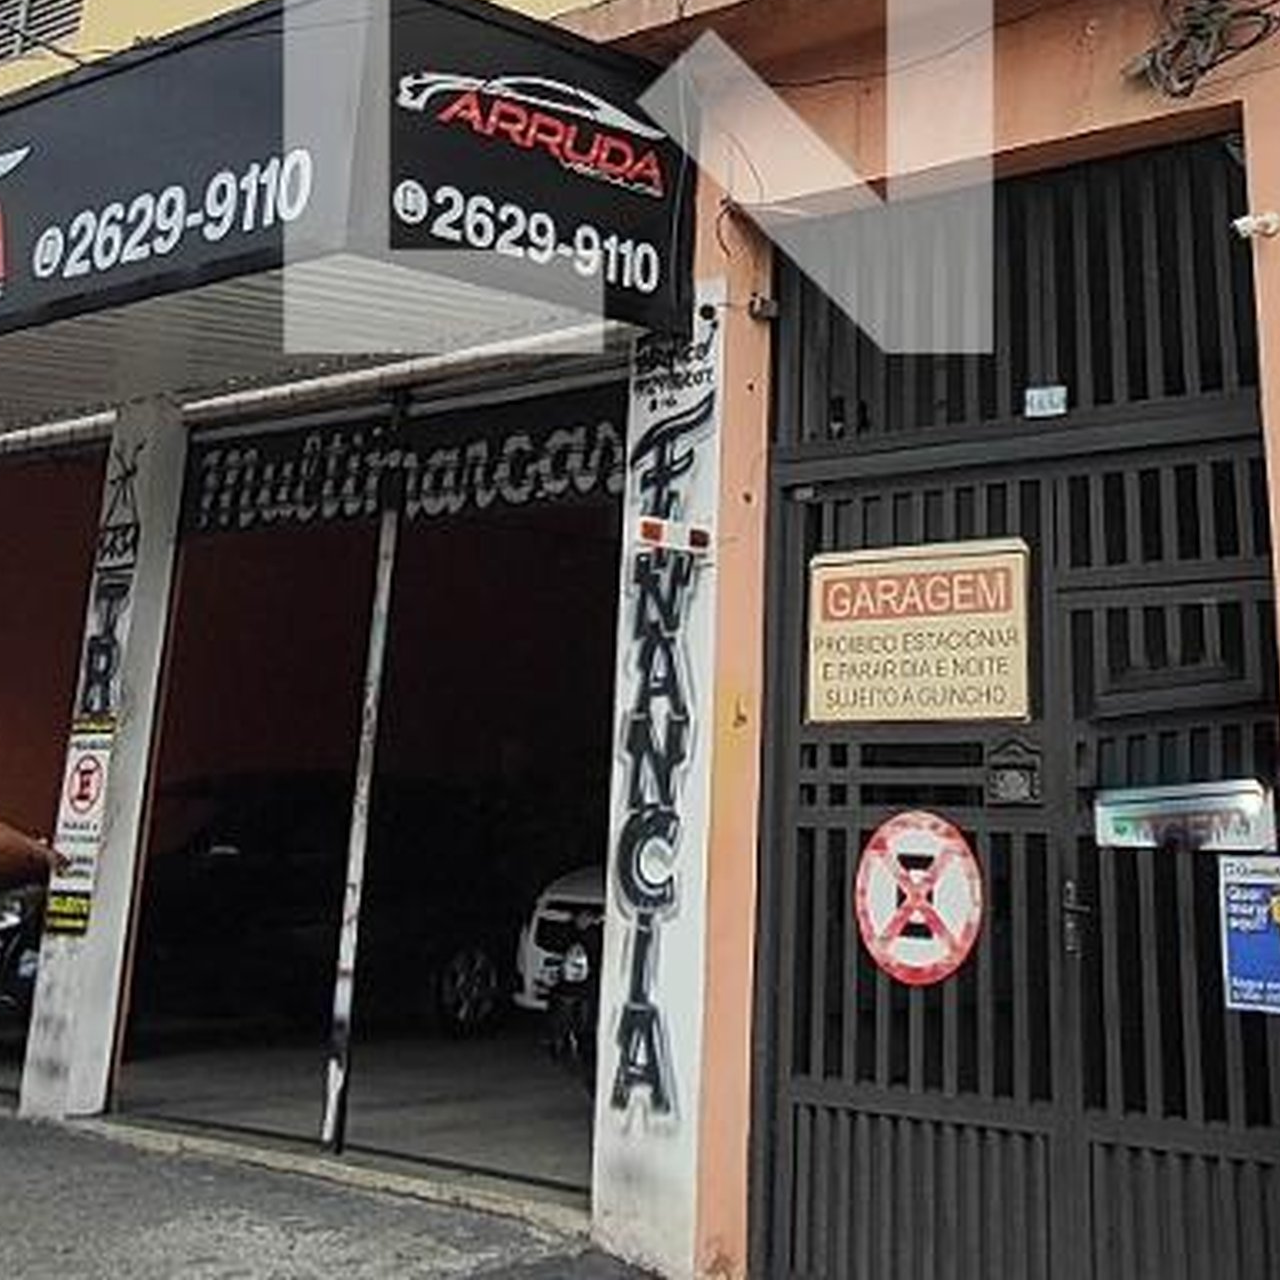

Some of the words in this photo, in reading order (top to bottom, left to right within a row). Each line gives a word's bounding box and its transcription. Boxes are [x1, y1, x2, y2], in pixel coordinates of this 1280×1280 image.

[437, 91, 664, 196] ARRUDA
[63, 149, 312, 279] 2629-9110
[430, 185, 659, 293] 2629-9110
[827, 572, 1007, 617] GARAGEM
[814, 635, 898, 656] PROIBIDO
[902, 627, 1019, 652] ESTACIONAR
[823, 662, 834, 681] E
[839, 659, 897, 680] PARAR
[900, 658, 934, 678] DIA
[936, 658, 948, 677] E
[952, 656, 1010, 677] NOITE
[825, 686, 899, 709] SUJEITO
[902, 687, 914, 705] A
[917, 685, 1008, 706] GUINCHO
